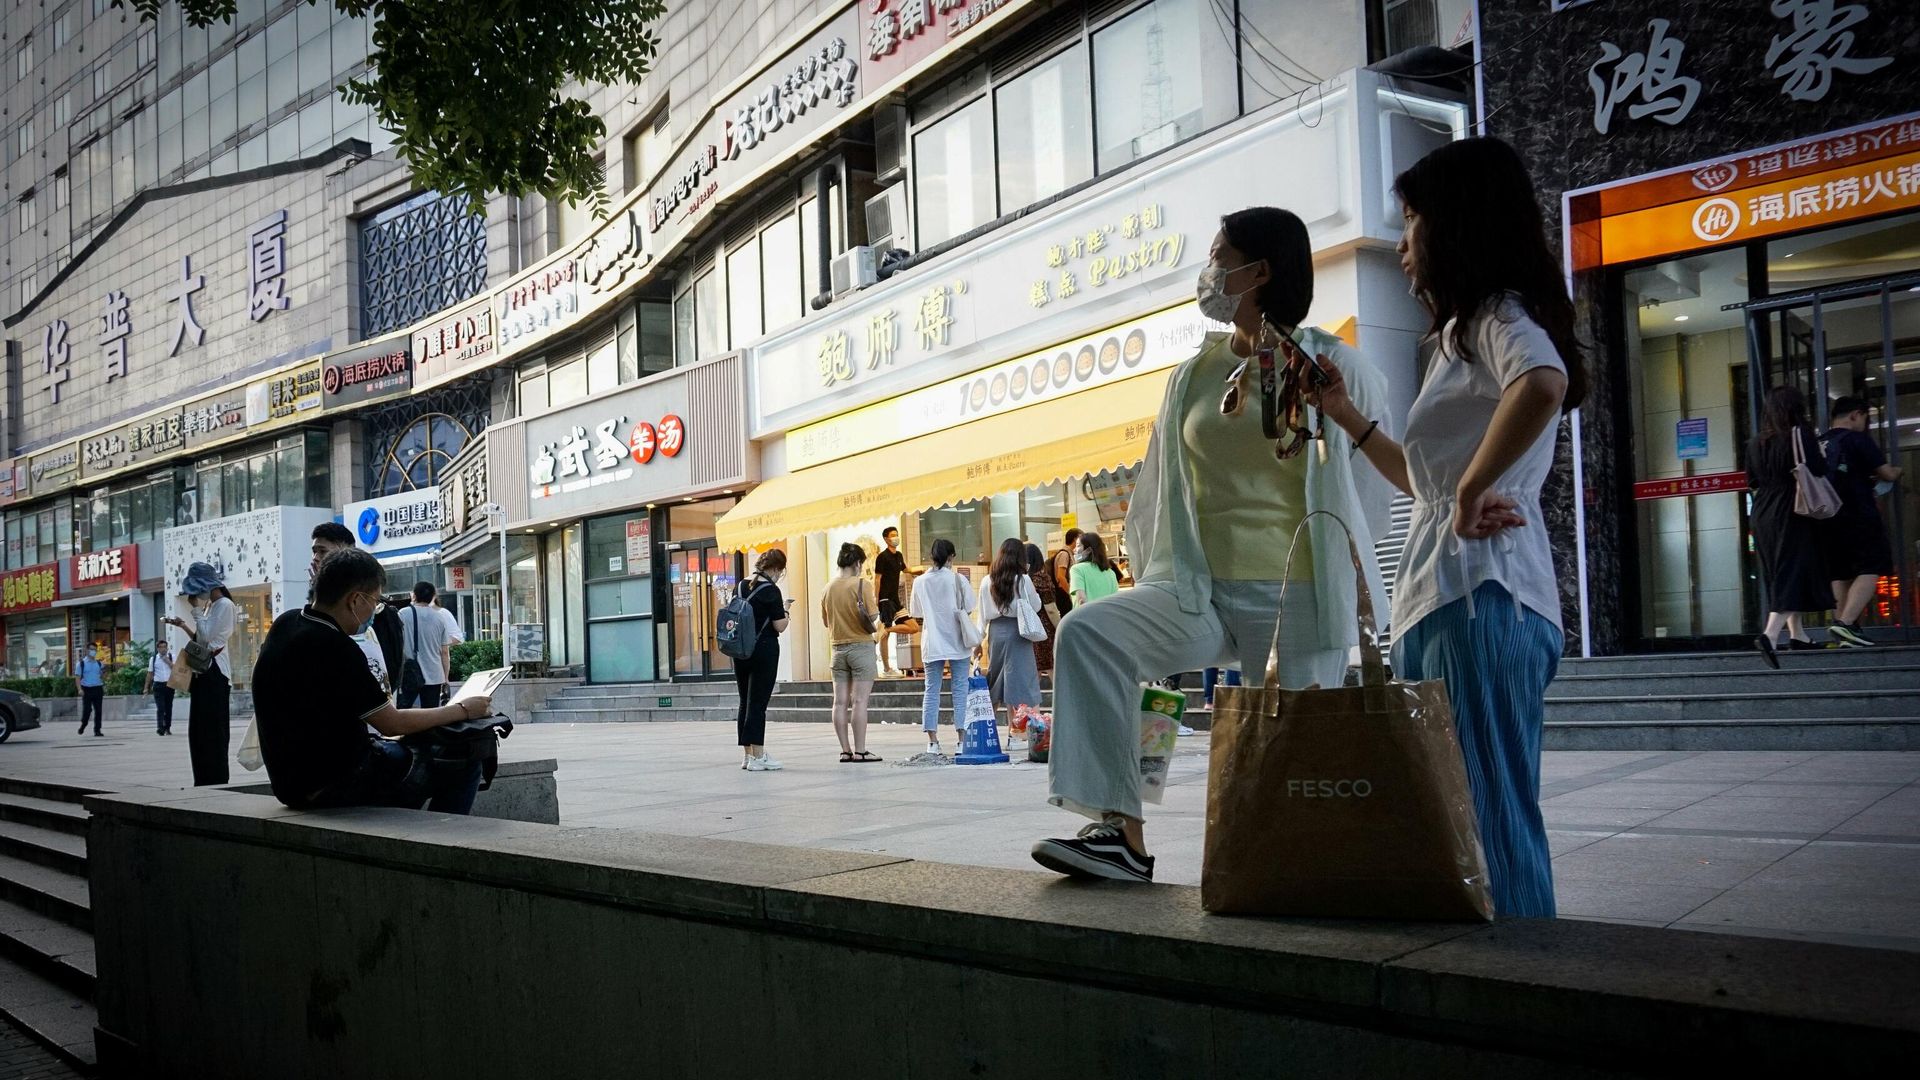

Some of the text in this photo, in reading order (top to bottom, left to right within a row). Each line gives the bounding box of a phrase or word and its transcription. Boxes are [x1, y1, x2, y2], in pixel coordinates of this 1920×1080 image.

[1748, 163, 1920, 226] 海底捞火锅
[1089, 232, 1185, 288] Pastry
[40, 209, 290, 405] 华普大厦
[817, 285, 953, 387] 鲍师傅
[342, 350, 406, 386] 海底捞火锅
[966, 463, 991, 480] 鲍师傅
[78, 549, 122, 580] 永和大王
[453, 567, 465, 589] 烟酒
[1287, 778, 1372, 798] FESCO
